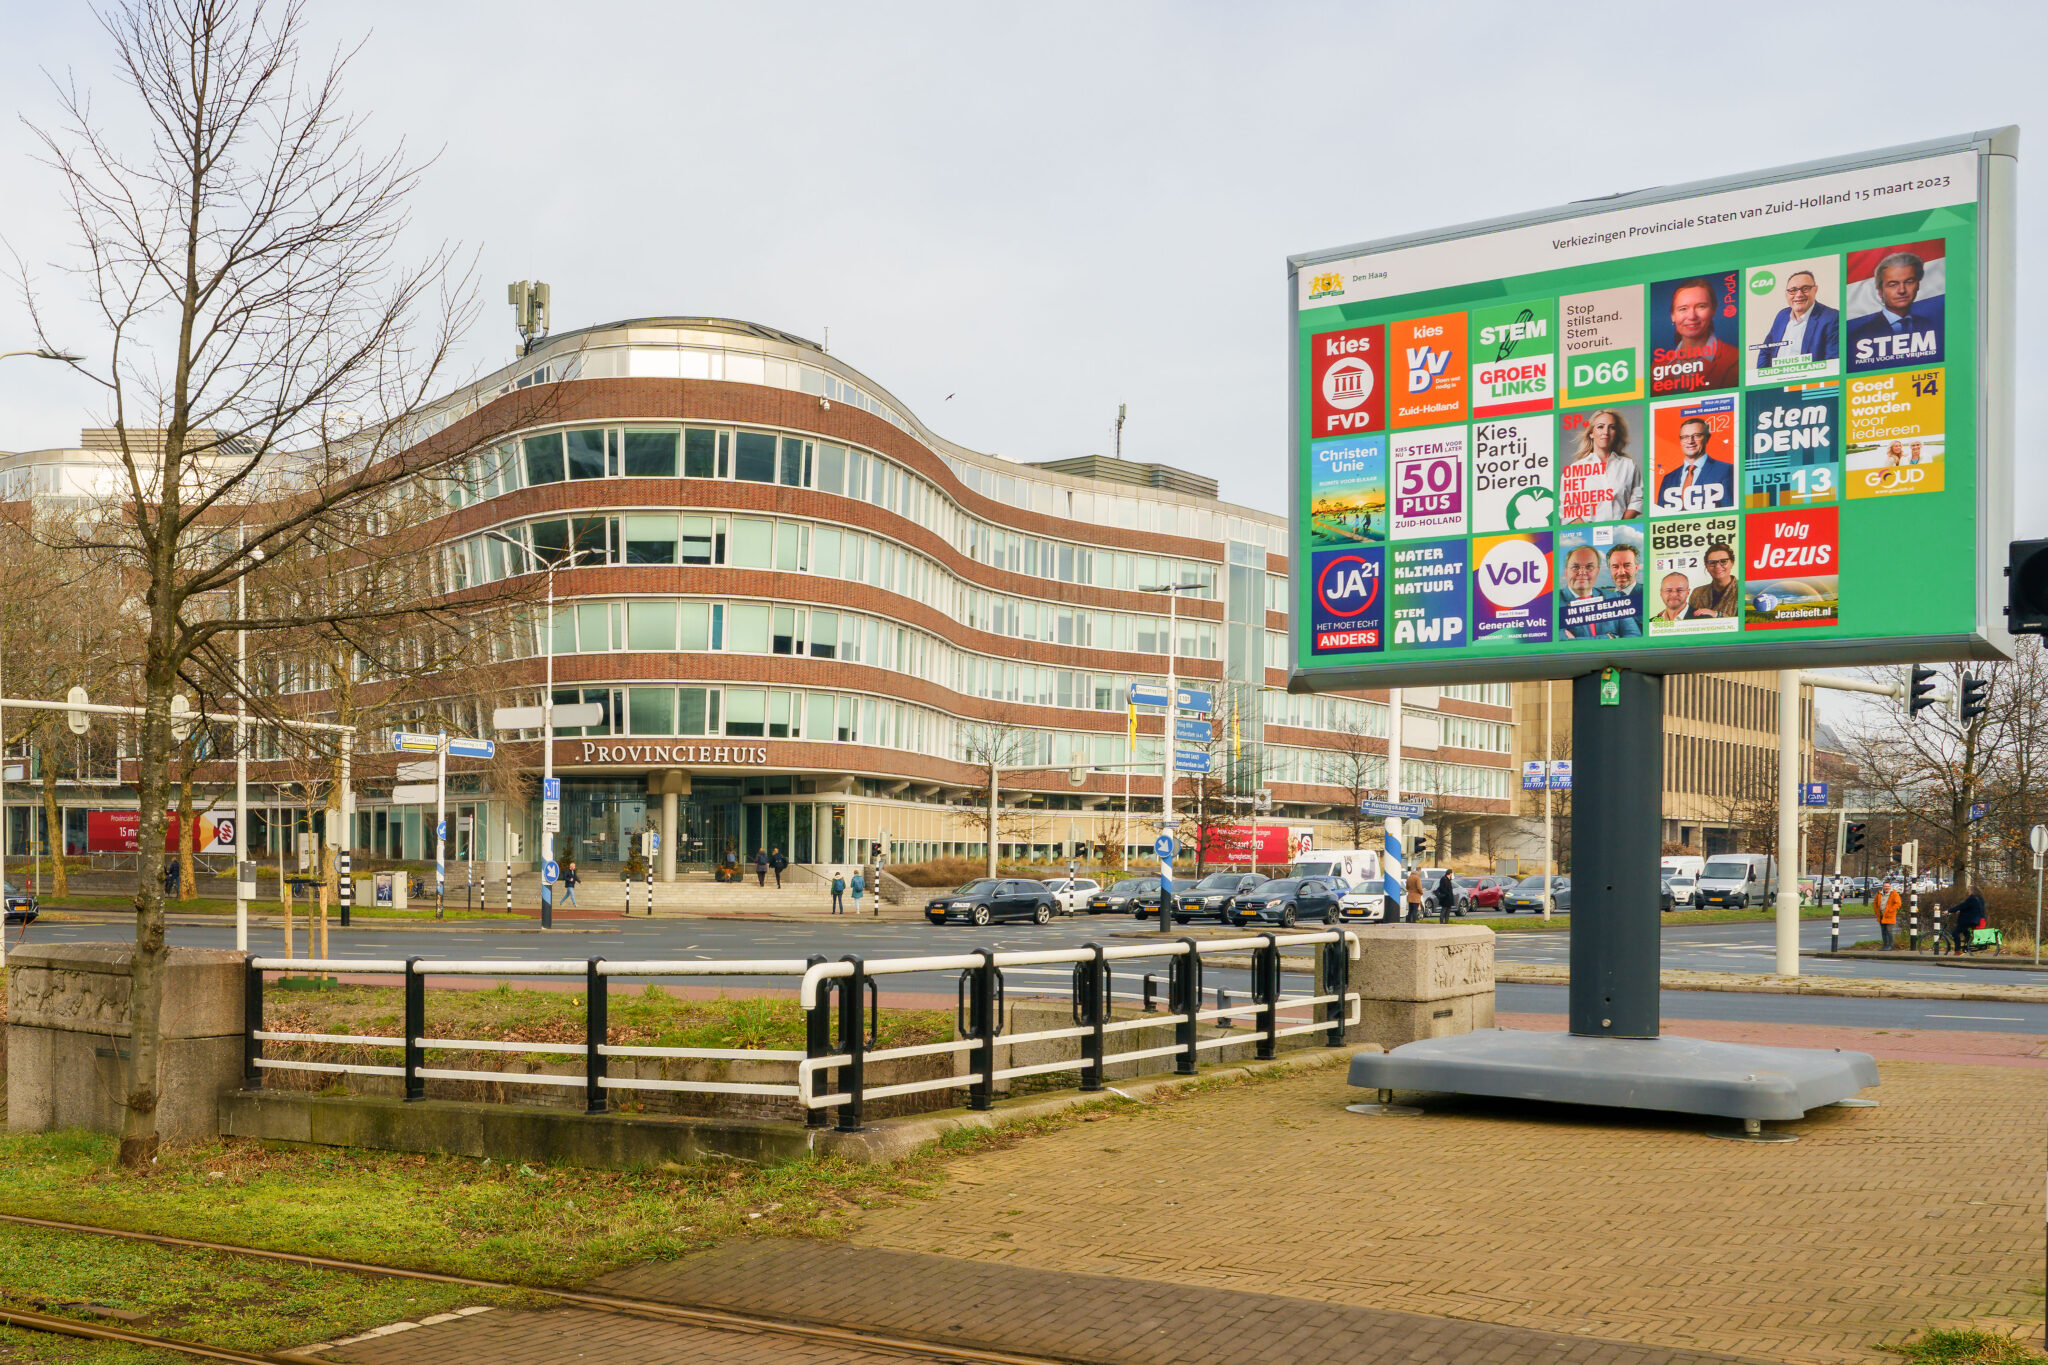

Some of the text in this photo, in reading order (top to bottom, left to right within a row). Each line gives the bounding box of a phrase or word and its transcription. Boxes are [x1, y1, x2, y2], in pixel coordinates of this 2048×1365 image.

[1552, 175, 1951, 250] Verkiezingen Provinciale Staten van Zuid-Holland 15 maart 2023
[1352, 270, 1388, 283] Den Haag
[1751, 277, 1775, 288] CDA
[1723, 273, 1737, 304] PvdA
[1567, 304, 1595, 316] Stop
[1567, 311, 1622, 328] stilstand.
[1413, 325, 1444, 339] kies
[1479, 319, 1547, 346] STEM
[1567, 326, 1598, 339] Stem
[1326, 335, 1370, 356] kies
[1567, 336, 1613, 351] vooruit.
[1653, 341, 1717, 363] Sociaal
[1855, 330, 1937, 359] STEM
[1773, 354, 1811, 366] THUIS IN
[1876, 354, 1895, 362] VOOR
[1479, 363, 1546, 385] GROEN
[1573, 360, 1629, 388] D66
[1653, 360, 1704, 380] groen
[1758, 363, 1826, 377] ZUID-HOLLAND
[1911, 371, 1940, 382] LIJST
[1491, 377, 1547, 398] LINKS
[1653, 374, 1710, 392] eerlijk.
[1851, 377, 1894, 393] Goed
[1911, 380, 1939, 397] 14
[1851, 390, 1899, 406] ouder
[1398, 400, 1459, 417] Zuid-Holland
[1851, 401, 1911, 417] worden
[1327, 411, 1370, 431] FVD
[1705, 415, 1731, 433] 12
[1756, 404, 1828, 431] stem
[1851, 414, 1887, 428] voor
[1477, 425, 1518, 441] Kies
[1753, 425, 1831, 454] DENK
[1851, 424, 1920, 441] iedereen
[1319, 446, 1378, 463] Christen
[1408, 442, 1444, 456] STEM
[1477, 437, 1528, 459] Partij
[1332, 458, 1365, 473] Unie
[1476, 452, 1549, 475] voor de
[1563, 461, 1607, 479] OMDAT
[1401, 460, 1453, 496] 50
[1477, 473, 1541, 492] Dieren
[1563, 477, 1585, 492] HET
[1752, 472, 1791, 486] LIJST
[1791, 467, 1832, 494] 13
[1402, 494, 1451, 513] PLUS
[1563, 488, 1614, 506] ANDERS
[1662, 483, 1724, 512] SGP
[1563, 504, 1597, 519] MOET
[1395, 515, 1462, 529] ZUID-HOLLAND
[1652, 517, 1736, 536] Iedere dag
[1774, 521, 1810, 540] Volg
[1652, 531, 1736, 551] BBBeter
[1394, 548, 1444, 562] WATER
[1688, 557, 1698, 568] 2
[1753, 543, 1832, 570] Jezus
[1394, 562, 1463, 579] KLIMAAT
[1485, 560, 1541, 586] Volt
[1667, 559, 1674, 570] 1
[1394, 579, 1454, 595] NATUUR
[1394, 607, 1425, 618] STEM
[1567, 607, 1578, 616] IN
[1579, 604, 1596, 614] HET
[1597, 598, 1632, 611] BELANG
[1774, 606, 1832, 620] Jezusleeft.nl
[1316, 619, 1379, 631] HET MOET ECHT
[1478, 618, 1547, 631] Generatie Volt
[1565, 608, 1636, 625] VAN NEDERLAND
[1394, 616, 1463, 644] AWP
[1320, 632, 1376, 647] ANDERS
[582, 741, 767, 763] PROVINCIEHUIS
[1371, 802, 1409, 812] Koningskade
[119, 826, 127, 837] 15
